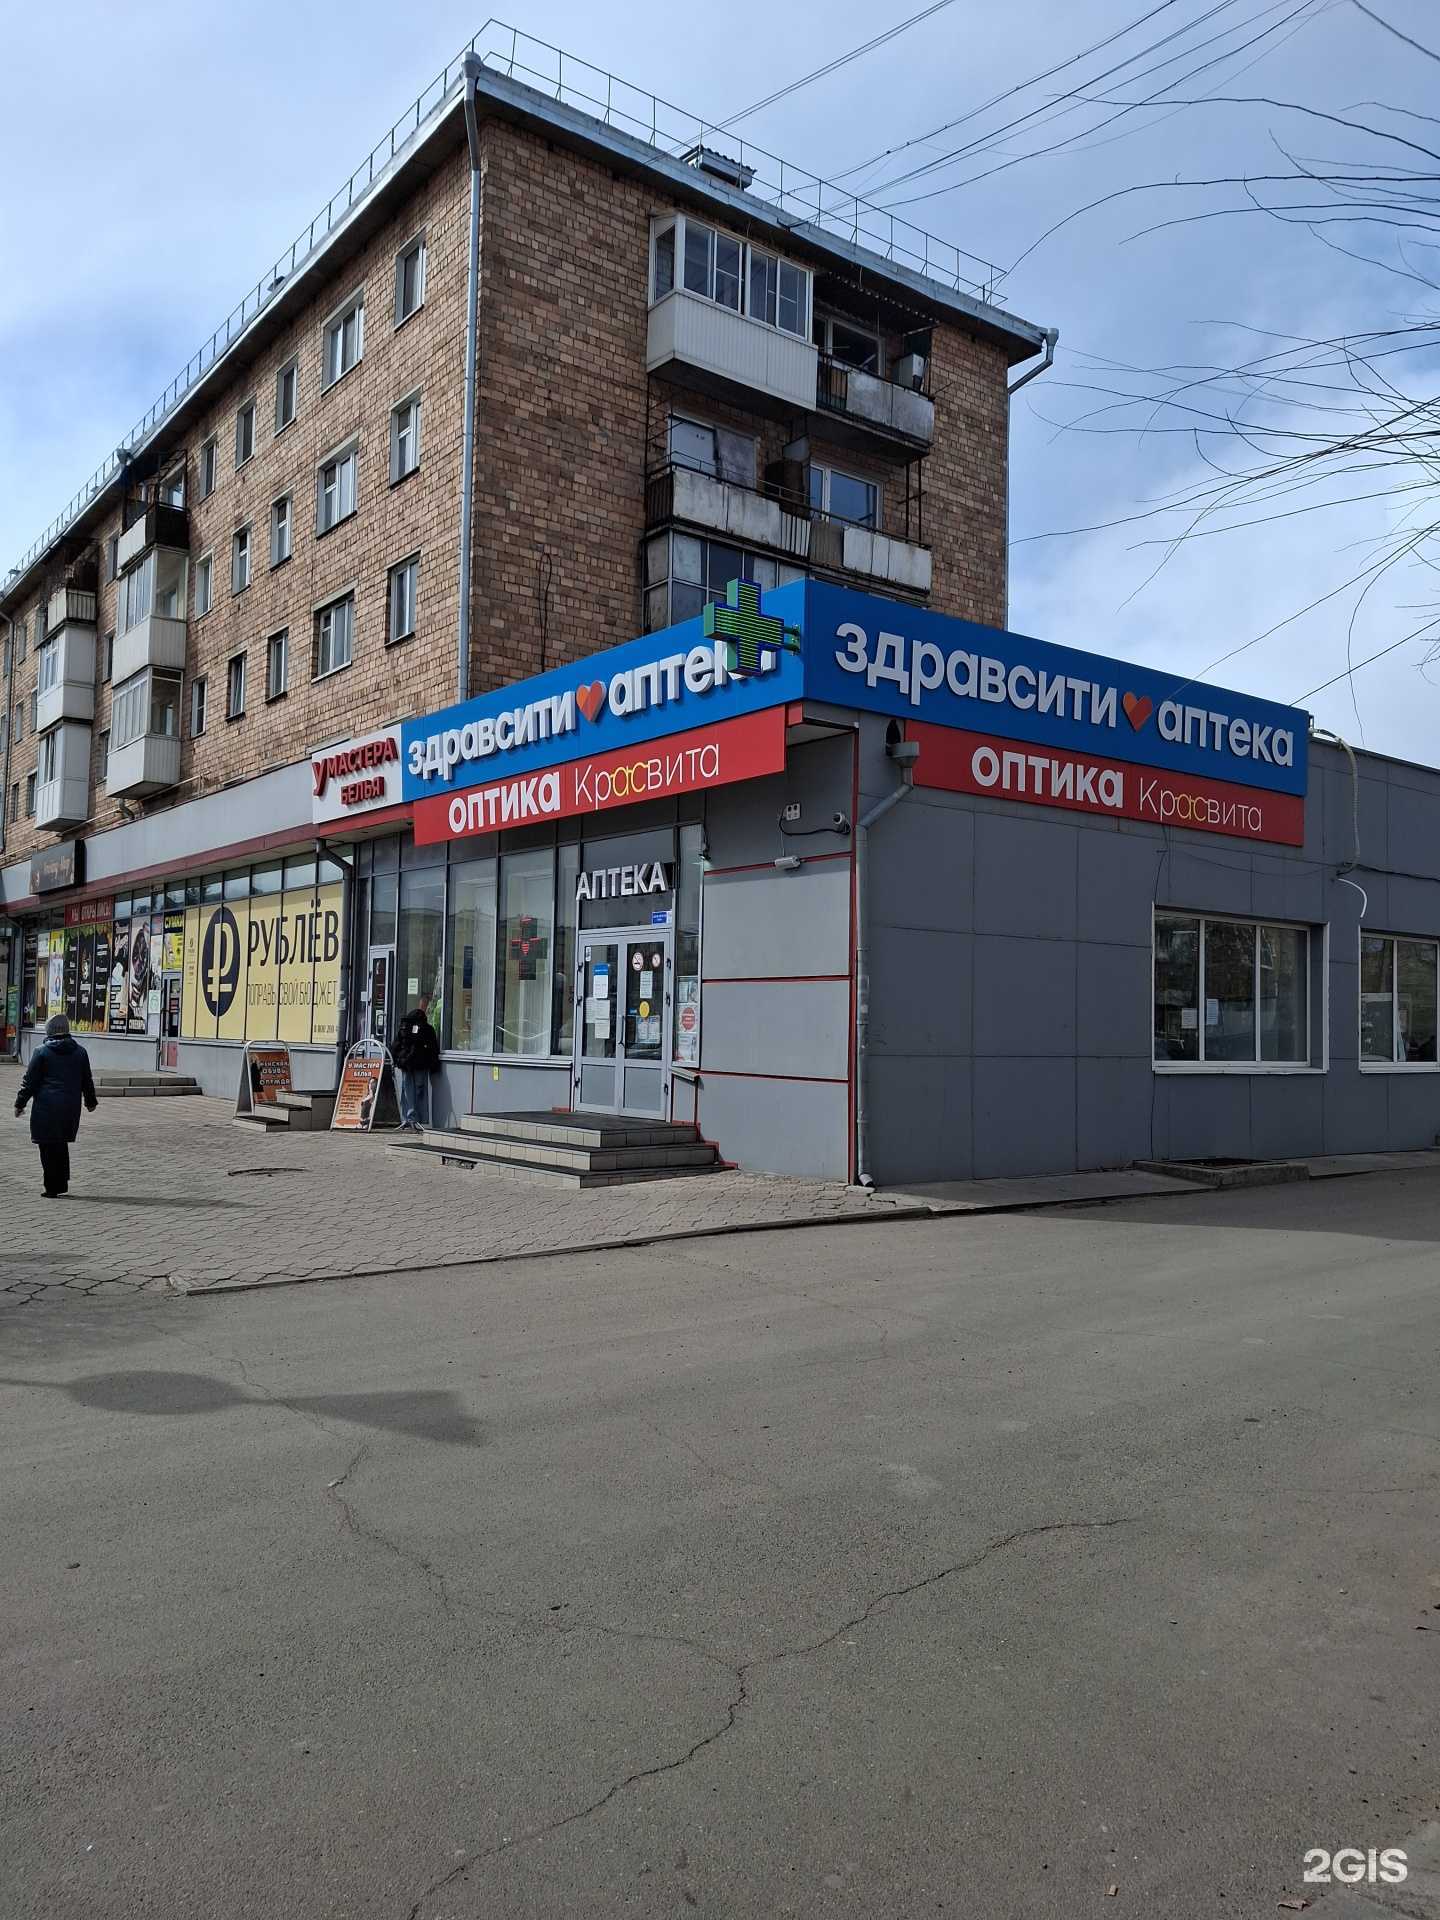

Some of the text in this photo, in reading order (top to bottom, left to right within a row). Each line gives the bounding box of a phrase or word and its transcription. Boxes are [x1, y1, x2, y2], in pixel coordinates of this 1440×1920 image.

[408, 640, 777, 781] здравсити аптек
[835, 622, 1294, 767] здравсити аптека
[312, 737, 398, 797] У МАСТЕРА
[341, 776, 385, 806] БЕЛЬЯ
[448, 741, 720, 833] оптика Красвита
[971, 746, 1263, 833] оптика Красвита
[576, 861, 667, 900] АПТЕКА
[247, 898, 340, 967] РУБЛЁВ
